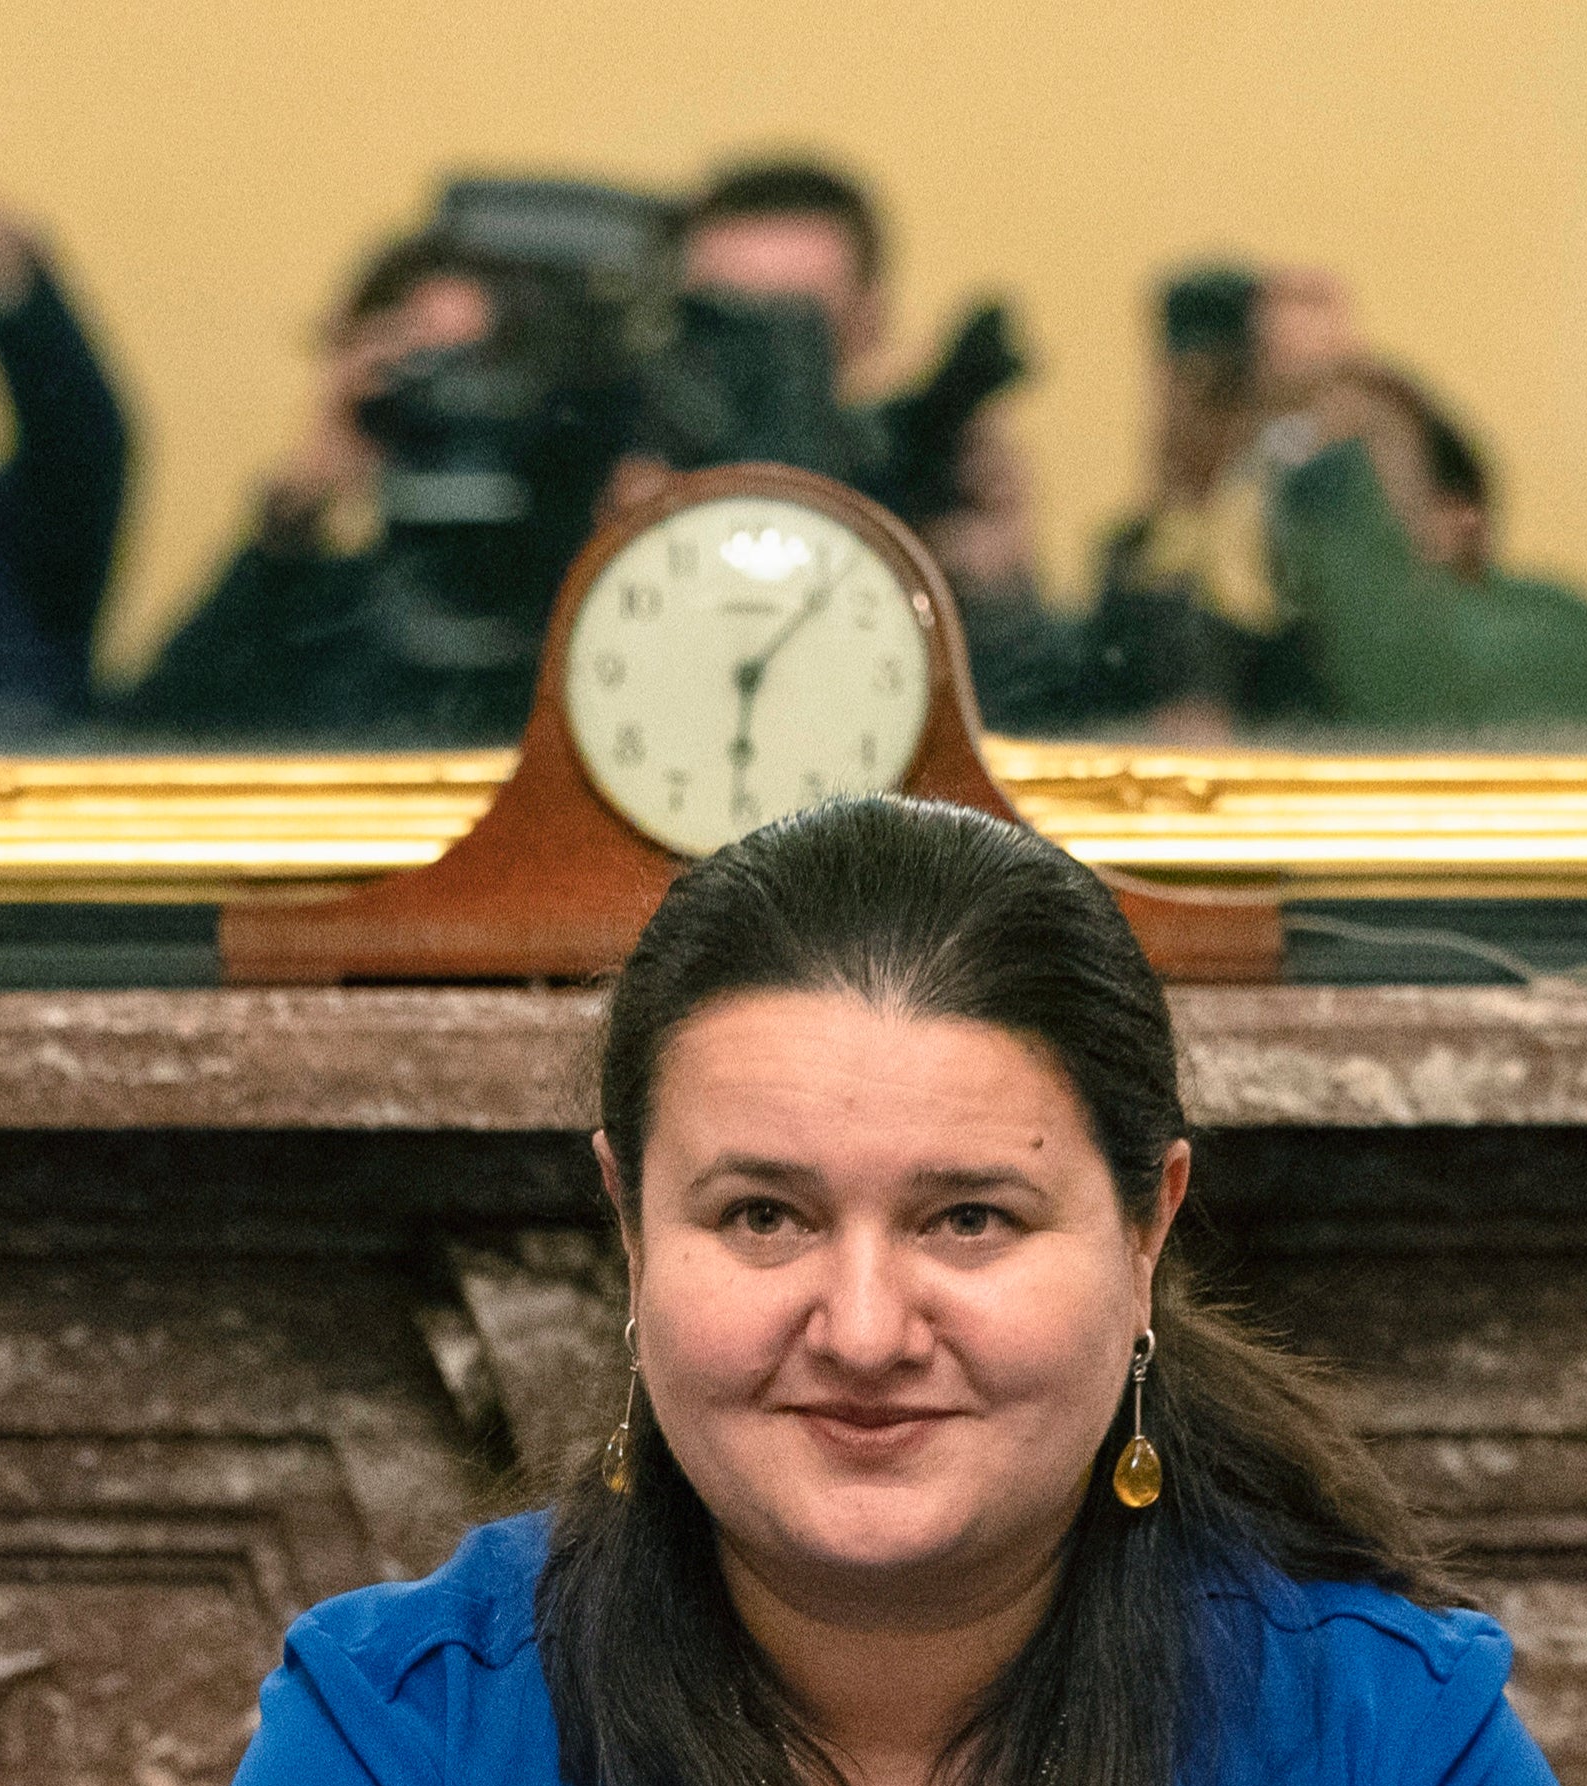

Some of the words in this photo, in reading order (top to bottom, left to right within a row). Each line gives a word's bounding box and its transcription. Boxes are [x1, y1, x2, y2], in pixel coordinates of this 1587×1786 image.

[619, 583, 664, 622] 10
[850, 588, 880, 632] 2
[595, 652, 628, 692] 9
[874, 656, 905, 696] 3
[612, 720, 648, 767] 8
[662, 768, 690, 814] 7
